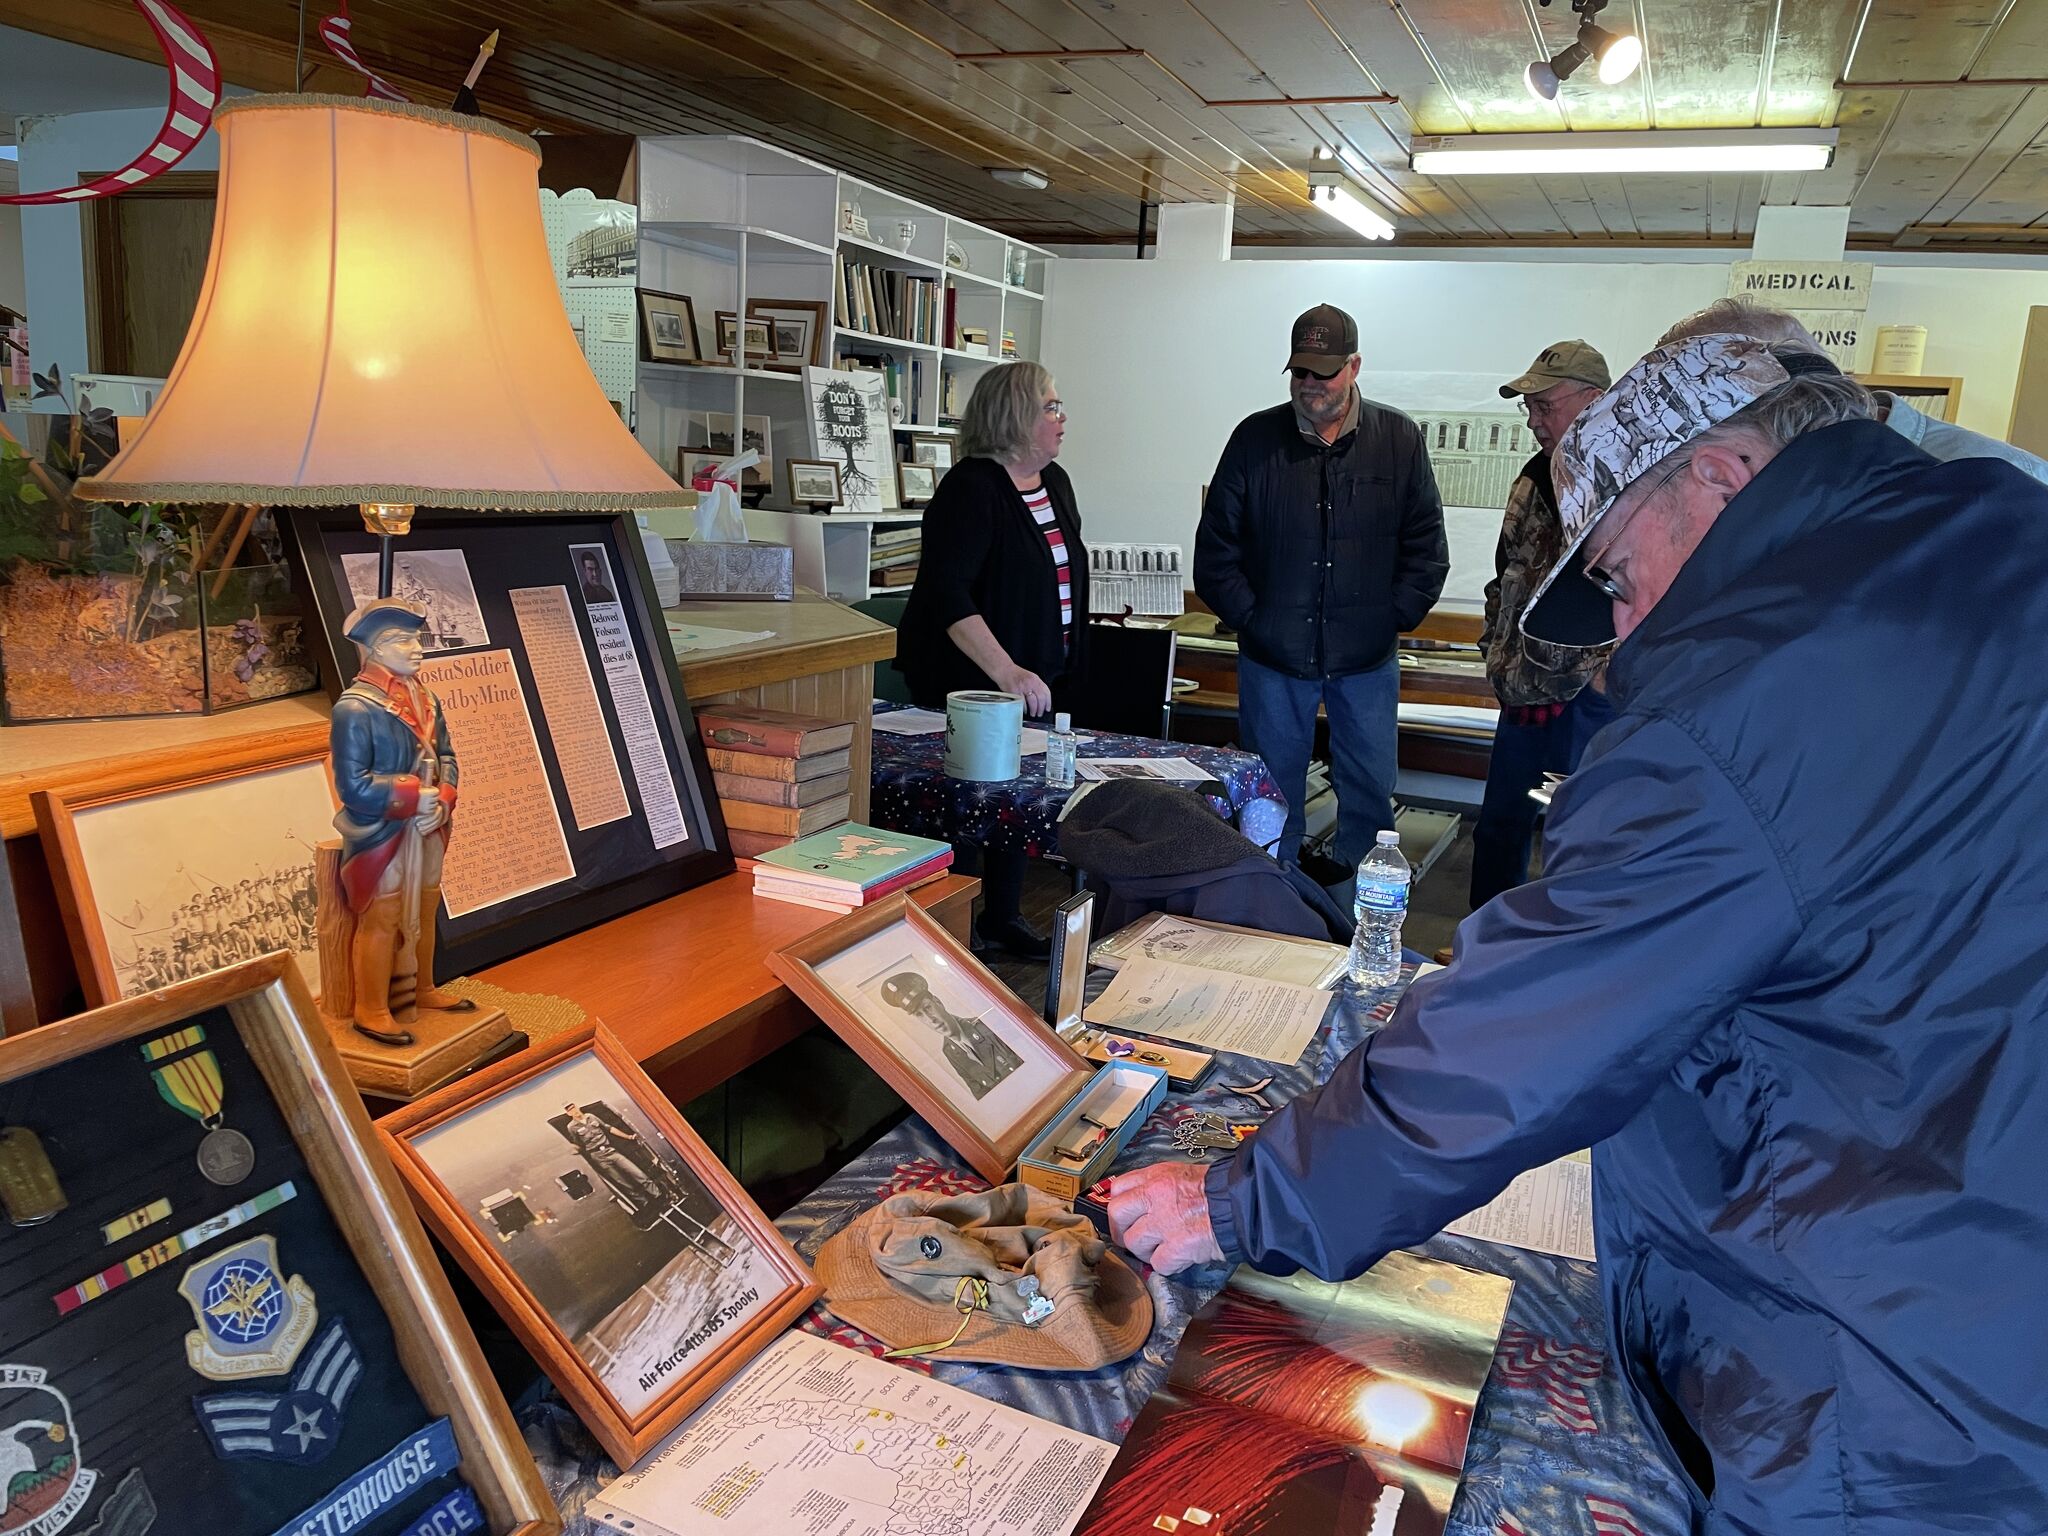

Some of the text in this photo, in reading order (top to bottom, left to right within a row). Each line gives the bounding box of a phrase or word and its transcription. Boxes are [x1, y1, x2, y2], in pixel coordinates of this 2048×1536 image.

[1746, 273, 1856, 290] MEDICAL
[828, 389, 855, 405] DON'T
[832, 424, 862, 437] ROOTS
[590, 612, 619, 624] Beloved
[594, 627, 621, 637] Folsom
[599, 639, 626, 651] resident
[603, 651, 634, 664] dies at 68
[459, 689, 479, 713] by
[478, 684, 518, 706] Mine
[478, 792, 505, 803] Swedish
[509, 787, 523, 796] Red
[467, 805, 490, 816] Korea
[522, 791, 547, 802] written
[722, 1287, 759, 1320] Spooky
[879, 1375, 902, 1396] SOUTH
[902, 1384, 922, 1403] CHINA
[926, 1395, 940, 1408] SEA
[938, 1404, 952, 1419] Corps
[748, 1433, 766, 1447] Corps
[622, 1463, 656, 1490] South
[653, 1432, 693, 1464] Vietnam
[983, 1482, 999, 1497] Corps
[36, 1471, 95, 1536] VIETNAM
